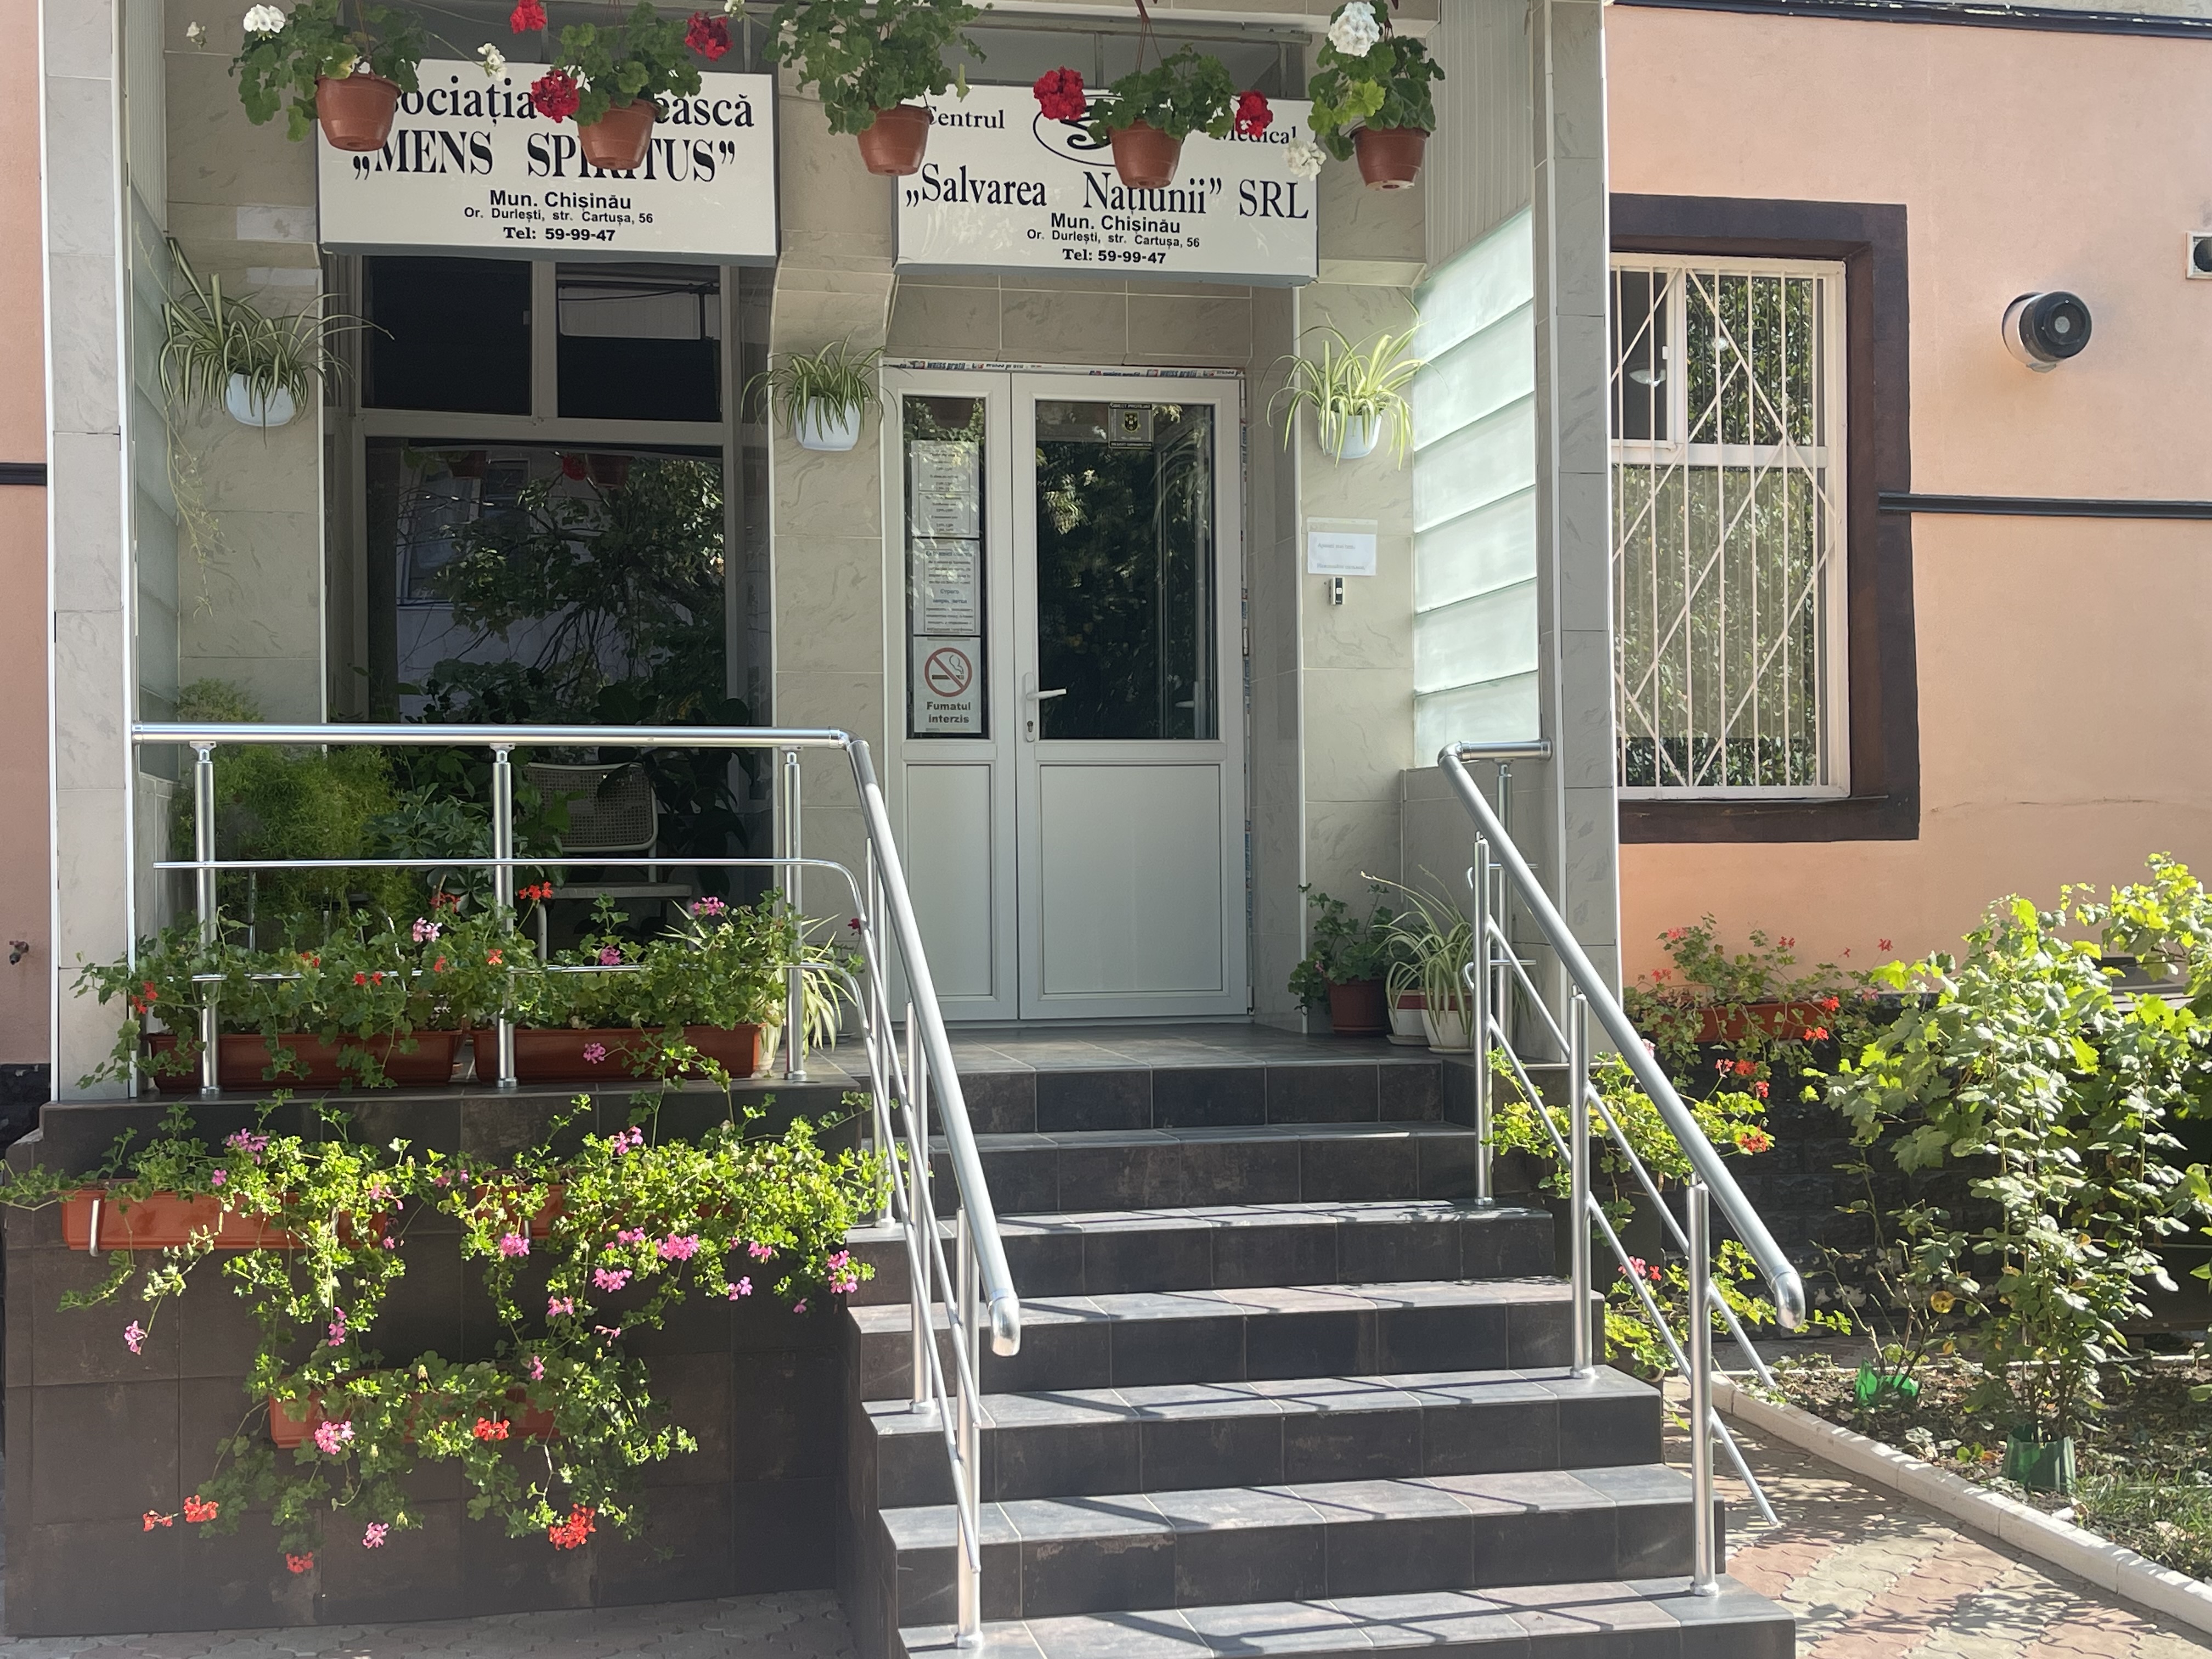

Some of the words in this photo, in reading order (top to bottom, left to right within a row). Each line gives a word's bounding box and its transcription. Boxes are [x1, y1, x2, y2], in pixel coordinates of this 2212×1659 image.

[395, 75, 538, 127] ociația
[655, 94, 754, 127] ească
[353, 129, 493, 180] „MENS
[528, 132, 735, 182] SPITUS”
[906, 163, 1047, 207] „Salvarea
[1239, 179, 1309, 219] SRL
[490, 190, 538, 207] Mun.
[545, 191, 631, 211] Chișinău
[464, 207, 483, 218] Or.
[552, 210, 573, 221] str.
[639, 212, 654, 223] 56
[1051, 212, 1095, 229] Mun.
[1101, 215, 1180, 234] Chișinău
[503, 227, 537, 239] Tel:
[545, 228, 616, 241] 59-99-47
[1027, 229, 1045, 239] Or.
[1108, 233, 1126, 244] str.
[1187, 237, 1200, 247] 56
[1063, 249, 1092, 261] Tel:
[1098, 250, 1166, 264] 59-99-47
[927, 702, 971, 710] Fumatul
[928, 714, 969, 723] interzis
